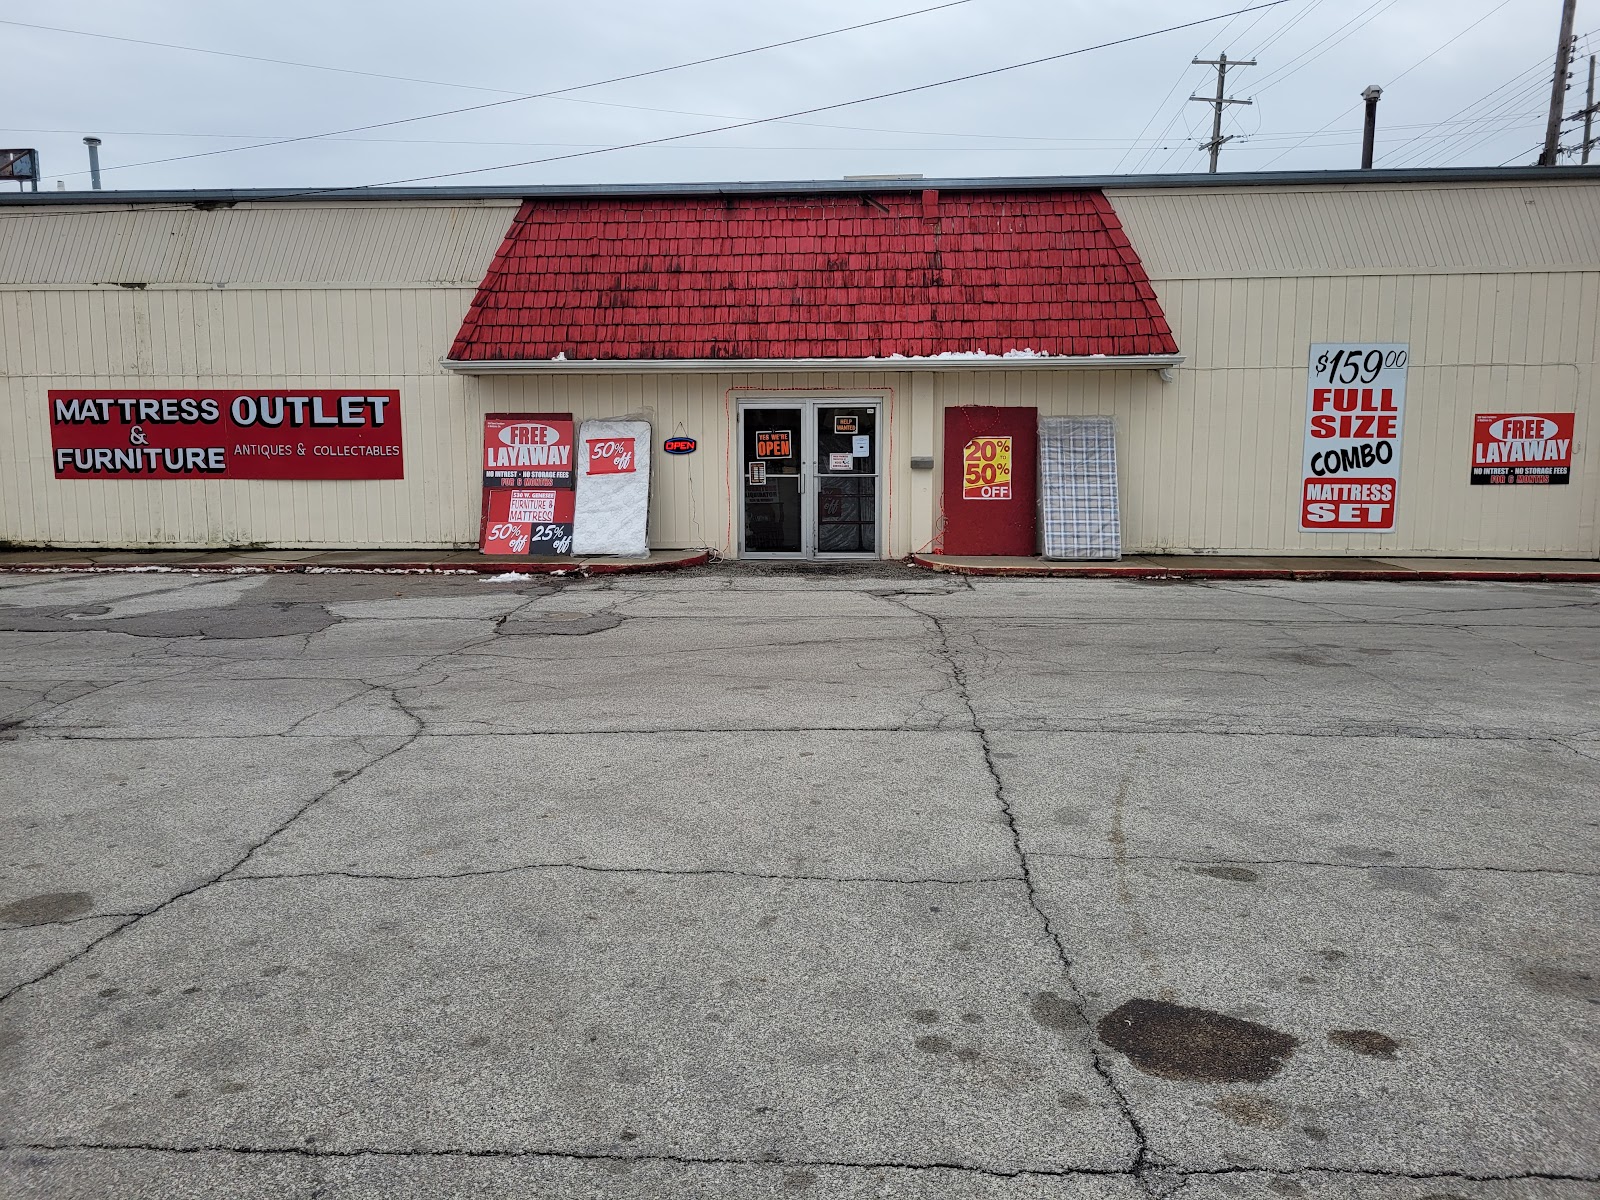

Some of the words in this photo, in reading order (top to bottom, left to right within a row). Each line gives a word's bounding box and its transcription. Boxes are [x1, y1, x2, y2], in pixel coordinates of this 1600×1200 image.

[1312, 388, 1398, 412] FULL
[55, 398, 220, 424] MATTRESS
[230, 395, 390, 428] OUTLET
[129, 425, 149, 445] &
[510, 426, 548, 444] FREE
[1310, 415, 1397, 438] SIZE
[1501, 420, 1545, 439] FREE
[234, 444, 292, 459] ANTIQUES
[296, 443, 306, 456] &
[313, 445, 400, 456] COLLECTABLES
[591, 441, 625, 460] 50%
[665, 441, 695, 450] OPEN
[758, 440, 790, 456] OPEN
[965, 440, 1010, 462] 20%
[1475, 439, 1570, 464] LAYAWAY
[56, 448, 226, 473] FURNITURE
[487, 445, 570, 467] LAYAWAY
[613, 451, 632, 470] off
[1311, 440, 1393, 476] COMBO
[965, 463, 1010, 484] 50%
[1490, 475, 1505, 483] FOR
[1508, 475, 1514, 483] 6
[1516, 475, 1550, 483] MONTHS
[1524, 467, 1553, 475] STORAGE
[501, 478, 515, 486] FOR
[517, 478, 522, 486] 6
[524, 478, 553, 487] MONTHS
[981, 486, 1009, 498] OFF
[1306, 484, 1392, 501] MATTRESS
[511, 500, 546, 509] FURNITURE
[548, 500, 553, 508] &
[1306, 503, 1390, 523] SET
[509, 510, 553, 521] MATTRESS
[488, 523, 522, 541] 50%
[532, 525, 564, 541] 25%
[509, 534, 528, 553] off
[552, 535, 572, 554] off
